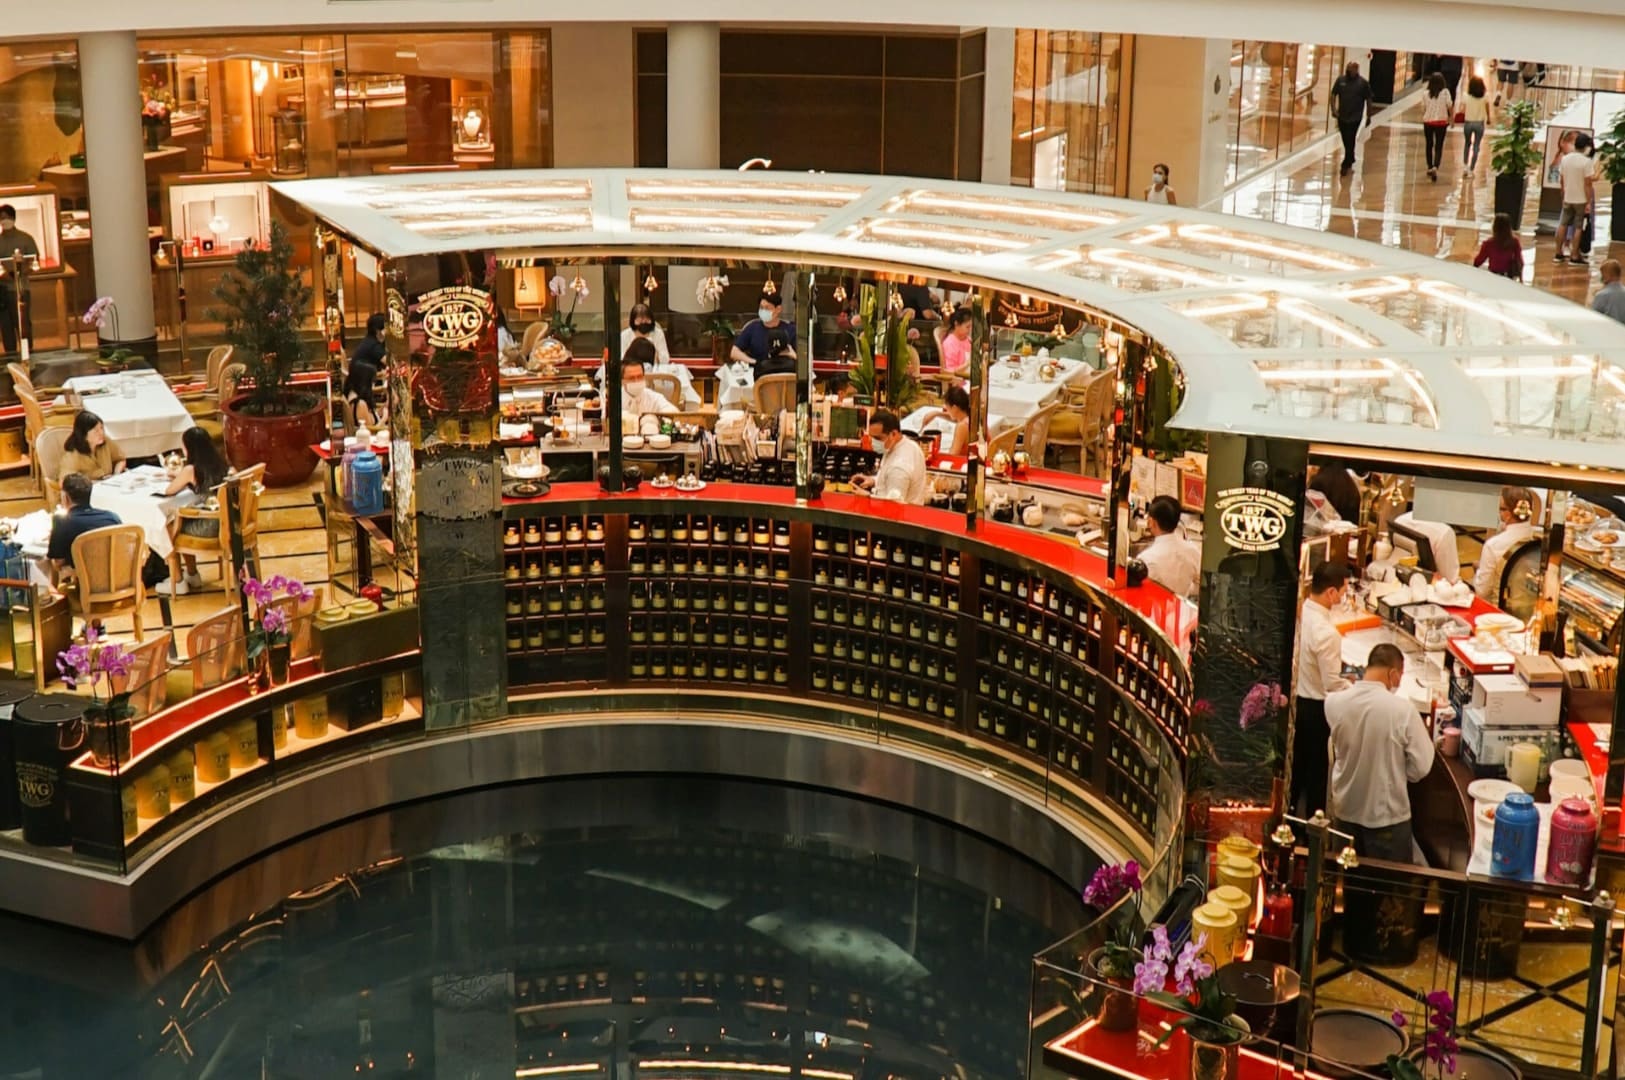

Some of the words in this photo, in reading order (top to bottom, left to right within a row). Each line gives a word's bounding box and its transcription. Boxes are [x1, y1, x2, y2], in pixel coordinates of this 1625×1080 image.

[442, 303, 465, 313] 1837
[428, 311, 479, 331] TWG
[441, 329, 466, 338] TEA
[1241, 506, 1266, 516] 1837
[1226, 513, 1281, 536] TWG
[1238, 531, 1265, 541] TEA
[19, 779, 49, 796] TWG
